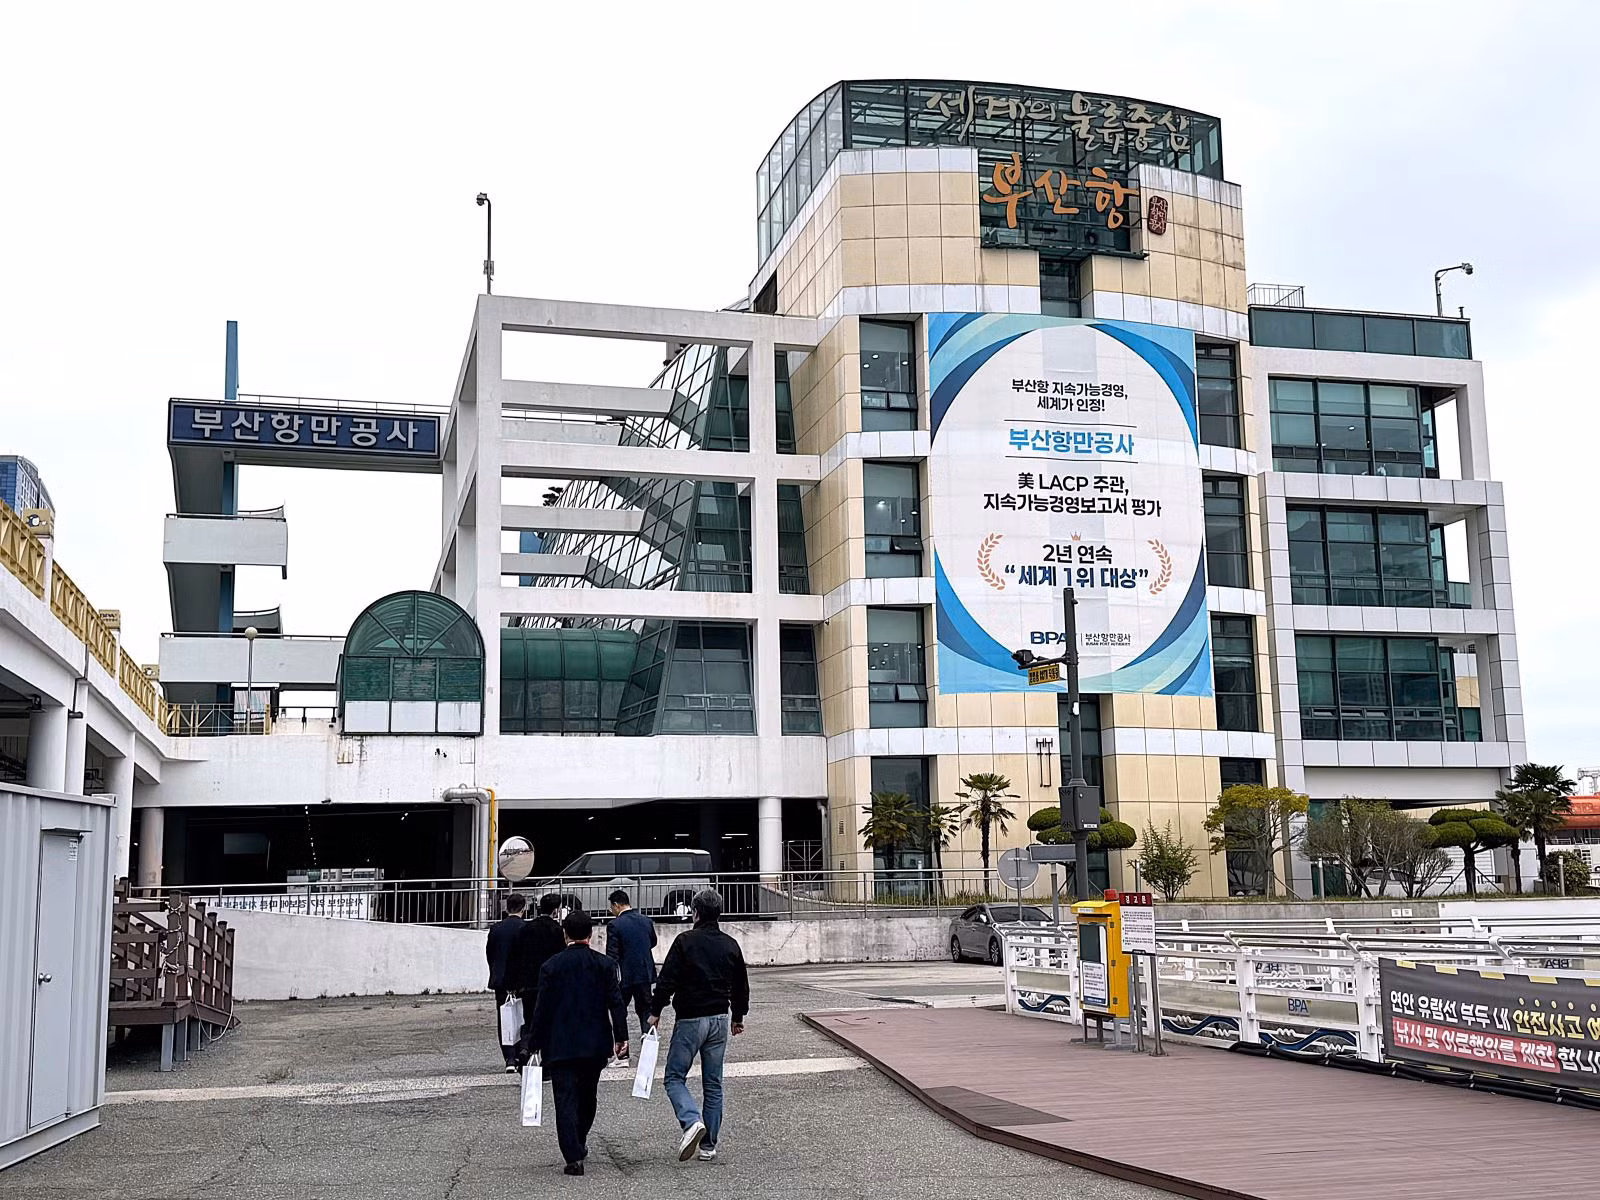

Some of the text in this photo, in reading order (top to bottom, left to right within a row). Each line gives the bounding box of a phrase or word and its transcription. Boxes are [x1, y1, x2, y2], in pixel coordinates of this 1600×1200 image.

[983, 152, 1139, 229] 부산항
[1011, 379, 1128, 400] 부산항 지속가능경영,
[1037, 397, 1105, 412] 세계가 인정!
[191, 408, 418, 448] 부산항만공사
[1009, 429, 1134, 456] 부산항만공사
[1018, 472, 1129, 496] 美 LACP 주관,
[983, 493, 1162, 517] 지속가능경영보고서 평가
[1043, 545, 1113, 564] 2년 연속
[1063, 568, 1094, 588] 1위
[1101, 567, 1149, 589] 대상”
[1085, 633, 1131, 642] 부산항만공사
[1288, 998, 1308, 1013] BPA
[1390, 991, 1415, 1015] 연안
[1418, 996, 1458, 1023] 유람선
[1461, 1003, 1490, 1028] 부두
[1493, 1007, 1511, 1031] 내
[1513, 1009, 1584, 1039] 안전사고
[1396, 1021, 1422, 1046] 낚시
[1425, 1026, 1439, 1049] 및
[1441, 1030, 1517, 1062] 어로행위를
[1520, 1042, 1556, 1068] 제한
